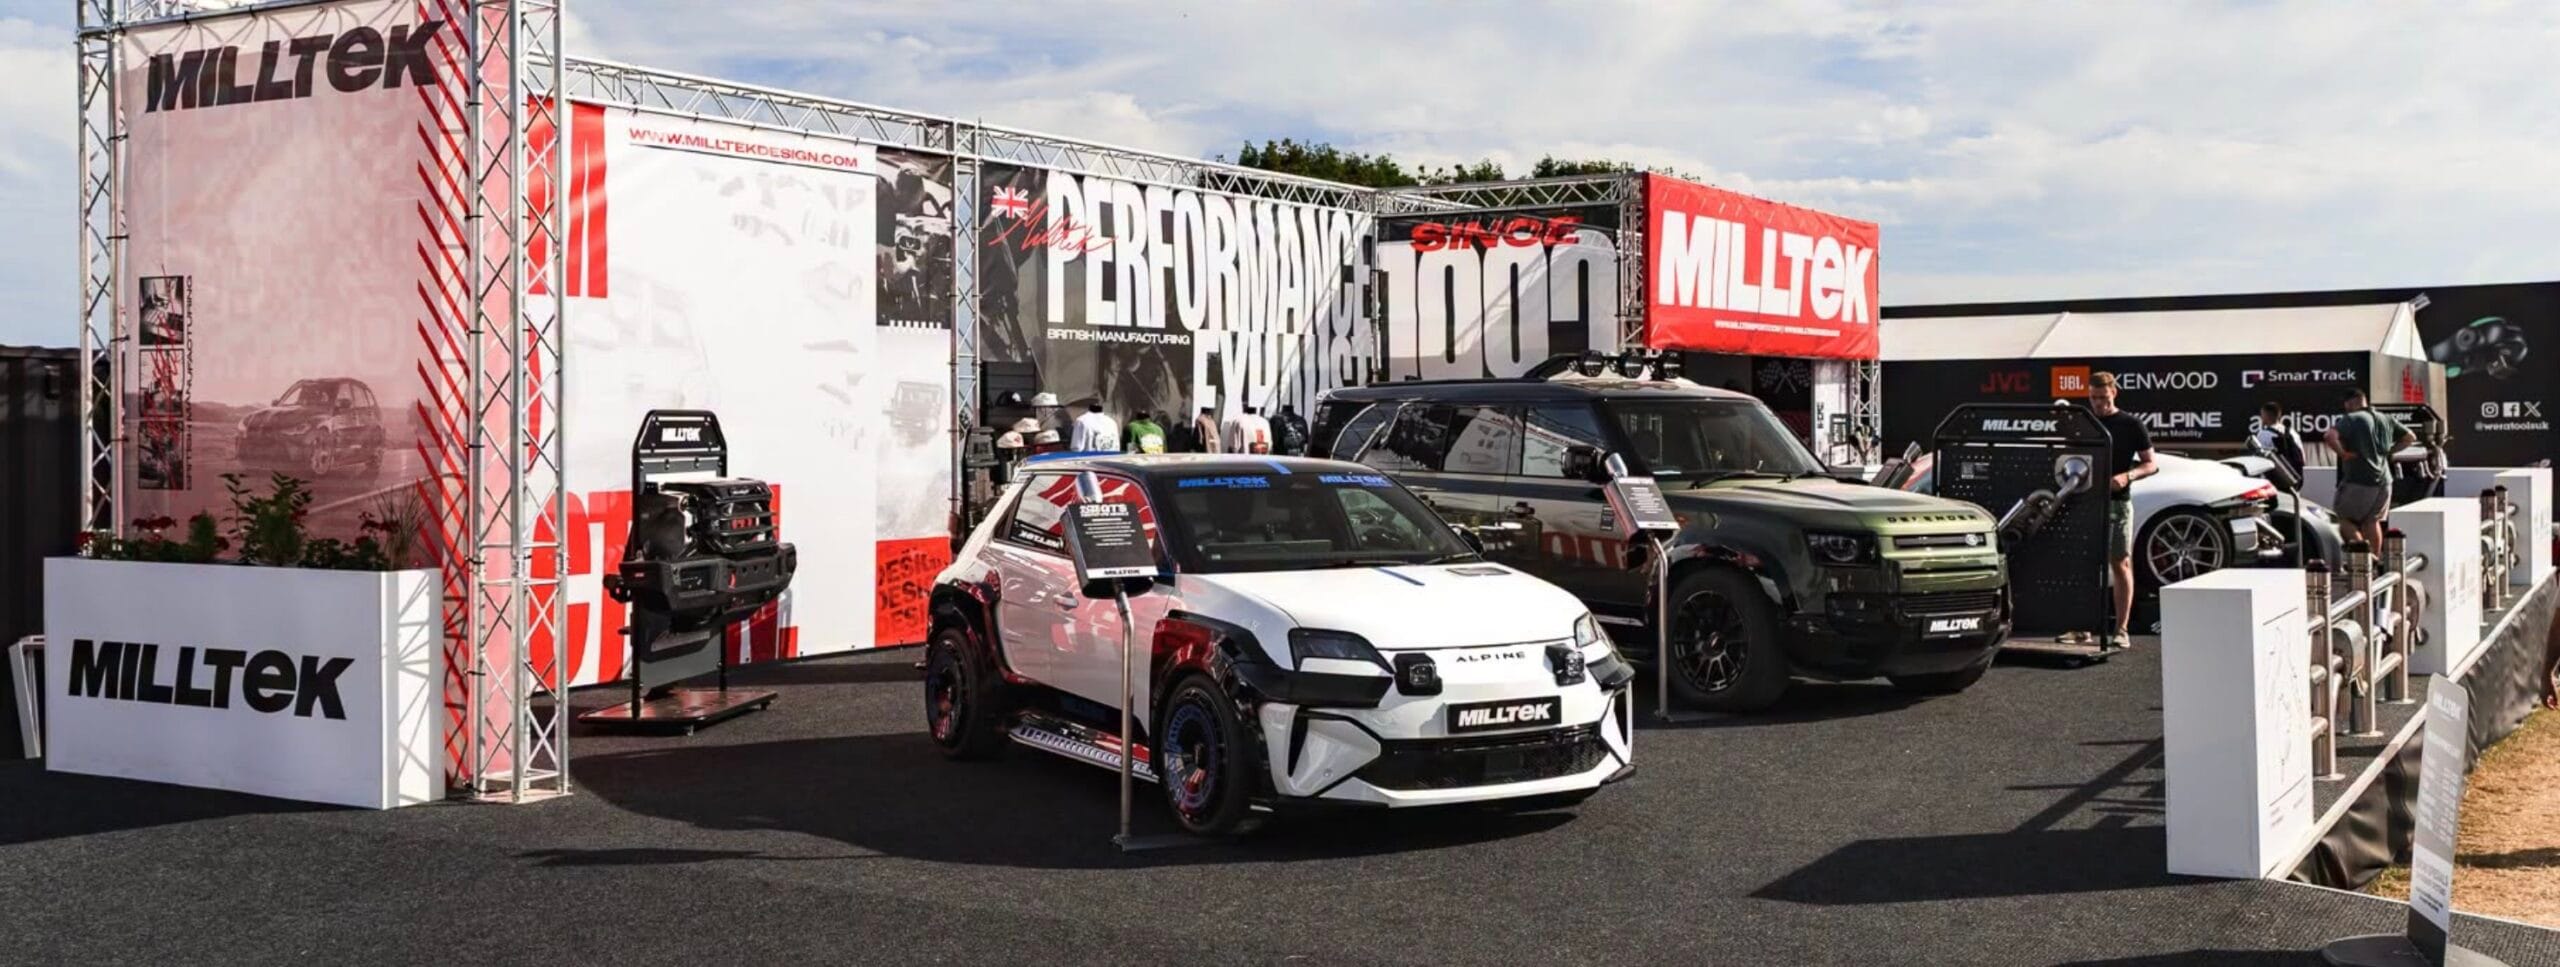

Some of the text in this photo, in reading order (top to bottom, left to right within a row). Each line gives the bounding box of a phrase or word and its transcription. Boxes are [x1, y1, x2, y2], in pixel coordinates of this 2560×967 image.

[629, 128, 858, 168] WWW.MILLTEKDESIGN.COM
[1410, 215, 1584, 253] SINCE
[1046, 171, 1373, 336] PERFORMANCE
[1047, 328, 1190, 345] BRITISH MANUFACTURING
[1980, 372, 2031, 393] JVC
[2058, 375, 2084, 391] JBL
[2142, 411, 2222, 428] ALPINE
[1887, 514, 1978, 522] DEFENDER
[1456, 651, 1526, 663] ALPINE
